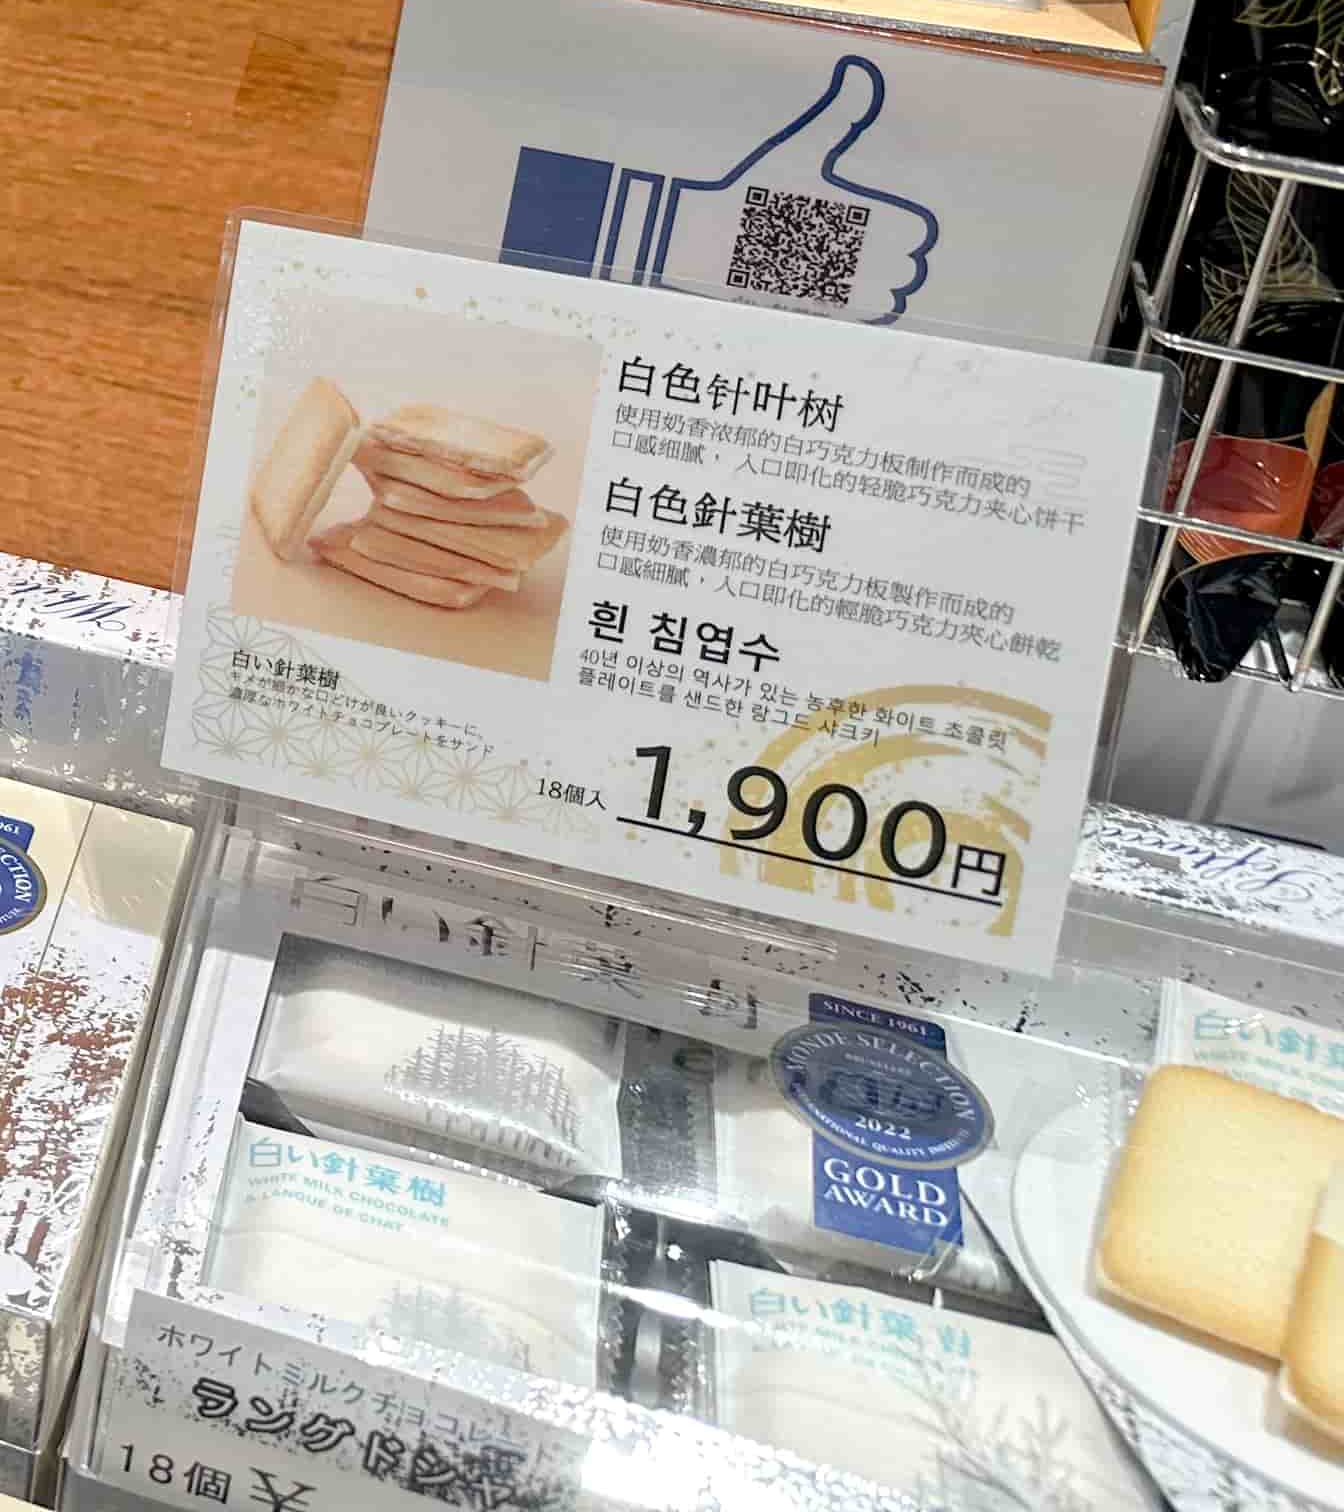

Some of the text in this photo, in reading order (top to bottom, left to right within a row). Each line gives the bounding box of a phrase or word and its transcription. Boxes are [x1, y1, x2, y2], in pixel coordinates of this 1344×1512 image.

[617, 355, 845, 434] 白色针叶树
[604, 477, 832, 554] 白色針葉樹
[230, 648, 341, 691] 白い針葉樹
[587, 599, 782, 673] 흰 침엽수
[576, 665, 678, 706] 플레이트를
[683, 689, 745, 719] 샌드한
[750, 701, 813, 732] 랑그드
[579, 648, 1011, 756] 40년 이상의 역사가 있는 농후한 화이트 초콜릿
[534, 776, 609, 813] 18個入
[632, 741, 1008, 899] 1,900円
[823, 998, 881, 1025] SINCE
[855, 1033, 977, 1122] SELECTION
[855, 1113, 913, 1141] 2022
[249, 1136, 446, 1208] 白い針葉樹
[823, 1156, 948, 1207] GOLD
[823, 1183, 949, 1227] AWARD
[119, 1442, 233, 1505] 18個
